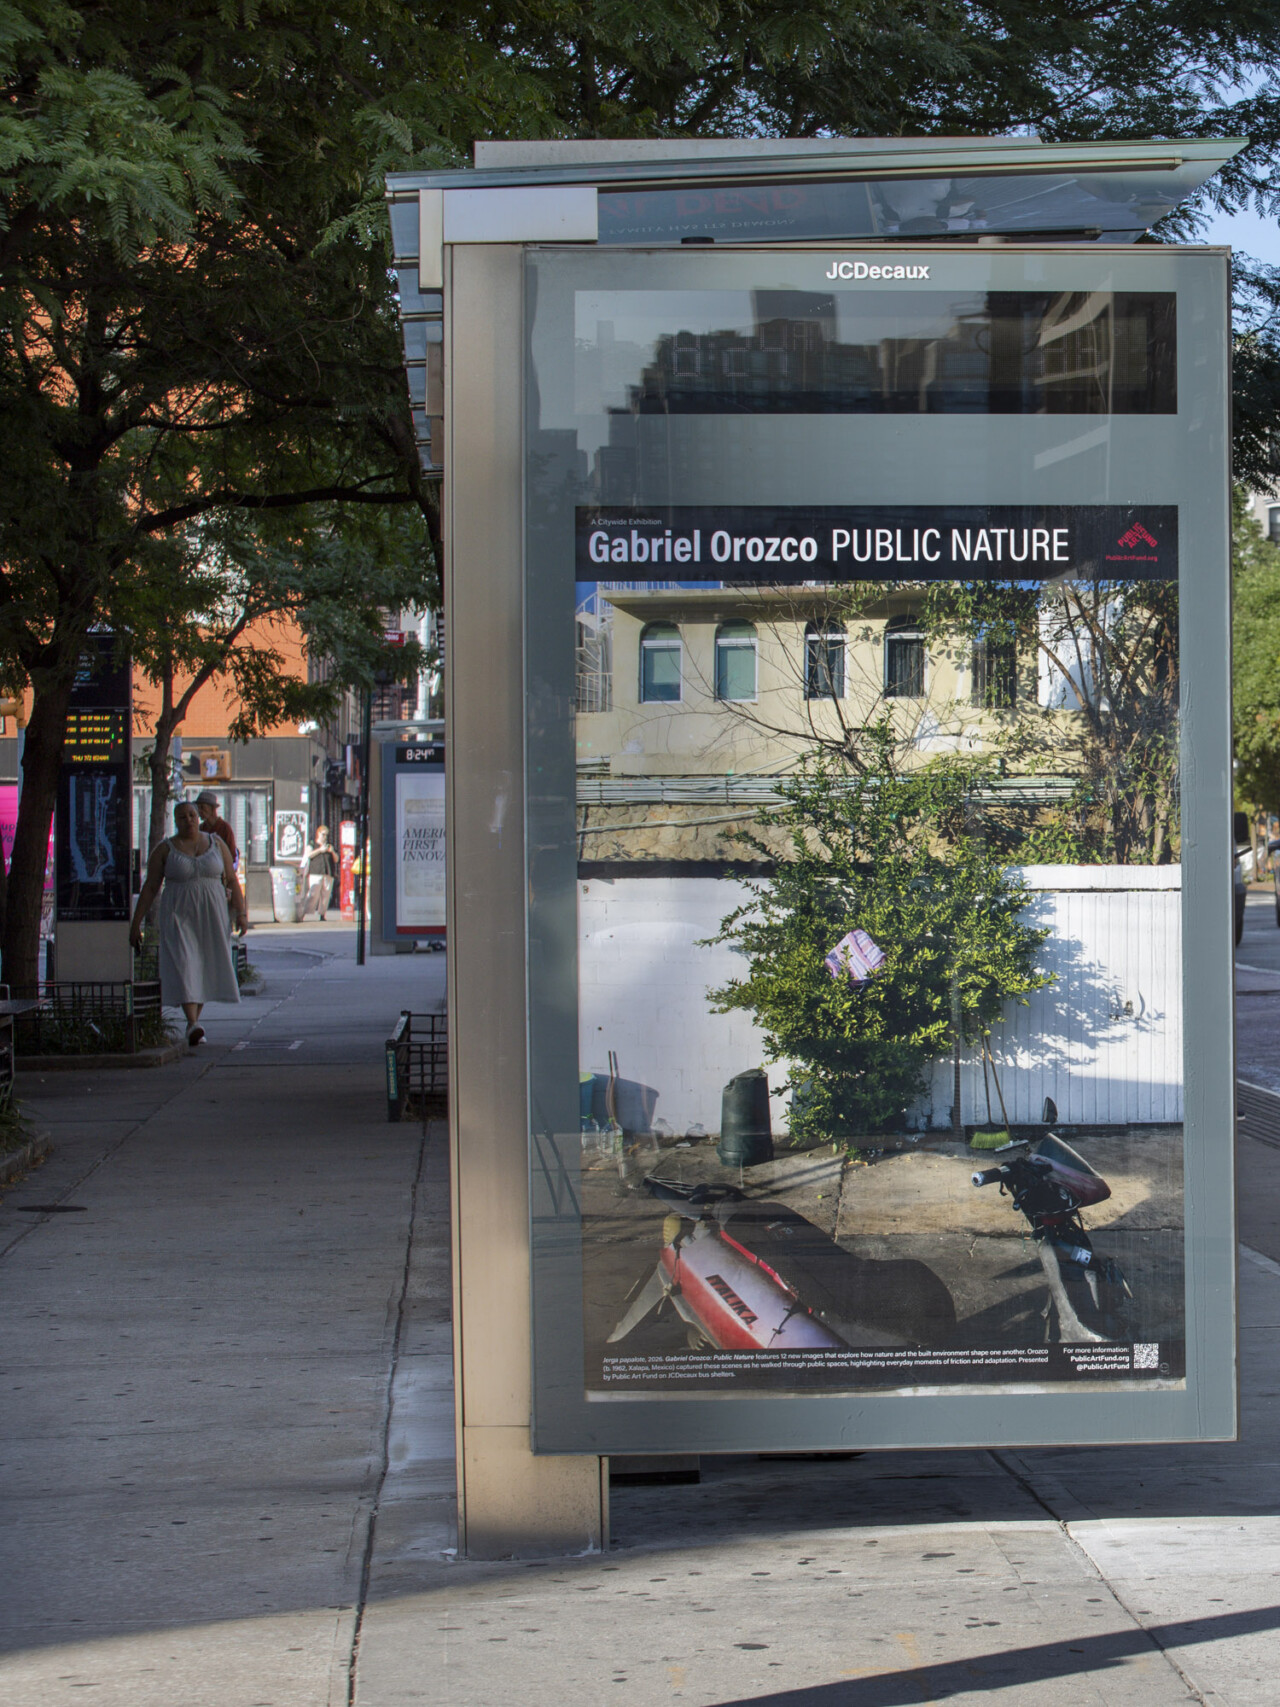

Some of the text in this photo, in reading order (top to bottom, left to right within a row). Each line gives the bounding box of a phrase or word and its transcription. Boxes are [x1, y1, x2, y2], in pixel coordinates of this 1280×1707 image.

[826, 262, 930, 280] JCDecaux
[591, 517, 662, 527] A Citywide Exhibition
[1117, 522, 1141, 547] PUBLIC
[589, 528, 1069, 562] Gabriel Orozco PUBLIC NATURE
[1105, 554, 1158, 563] PublicArtFund.org
[406, 749, 428, 760] 8:24
[276, 813, 306, 825] READ
[403, 839, 438, 850] FIRST
[706, 1275, 758, 1324] ITALIKA
[802, 1352, 824, 1360] images
[838, 1351, 860, 1359] explore
[970, 1349, 989, 1357] shape
[651, 1363, 675, 1371] Mexico)
[676, 1362, 703, 1370] captured
[782, 1360, 806, 1368] through
[807, 1360, 826, 1368] public
[850, 1359, 886, 1367] highlighting
[984, 1357, 1018, 1365] adaptation.
[1076, 1363, 1130, 1371] @PublicArtFund
